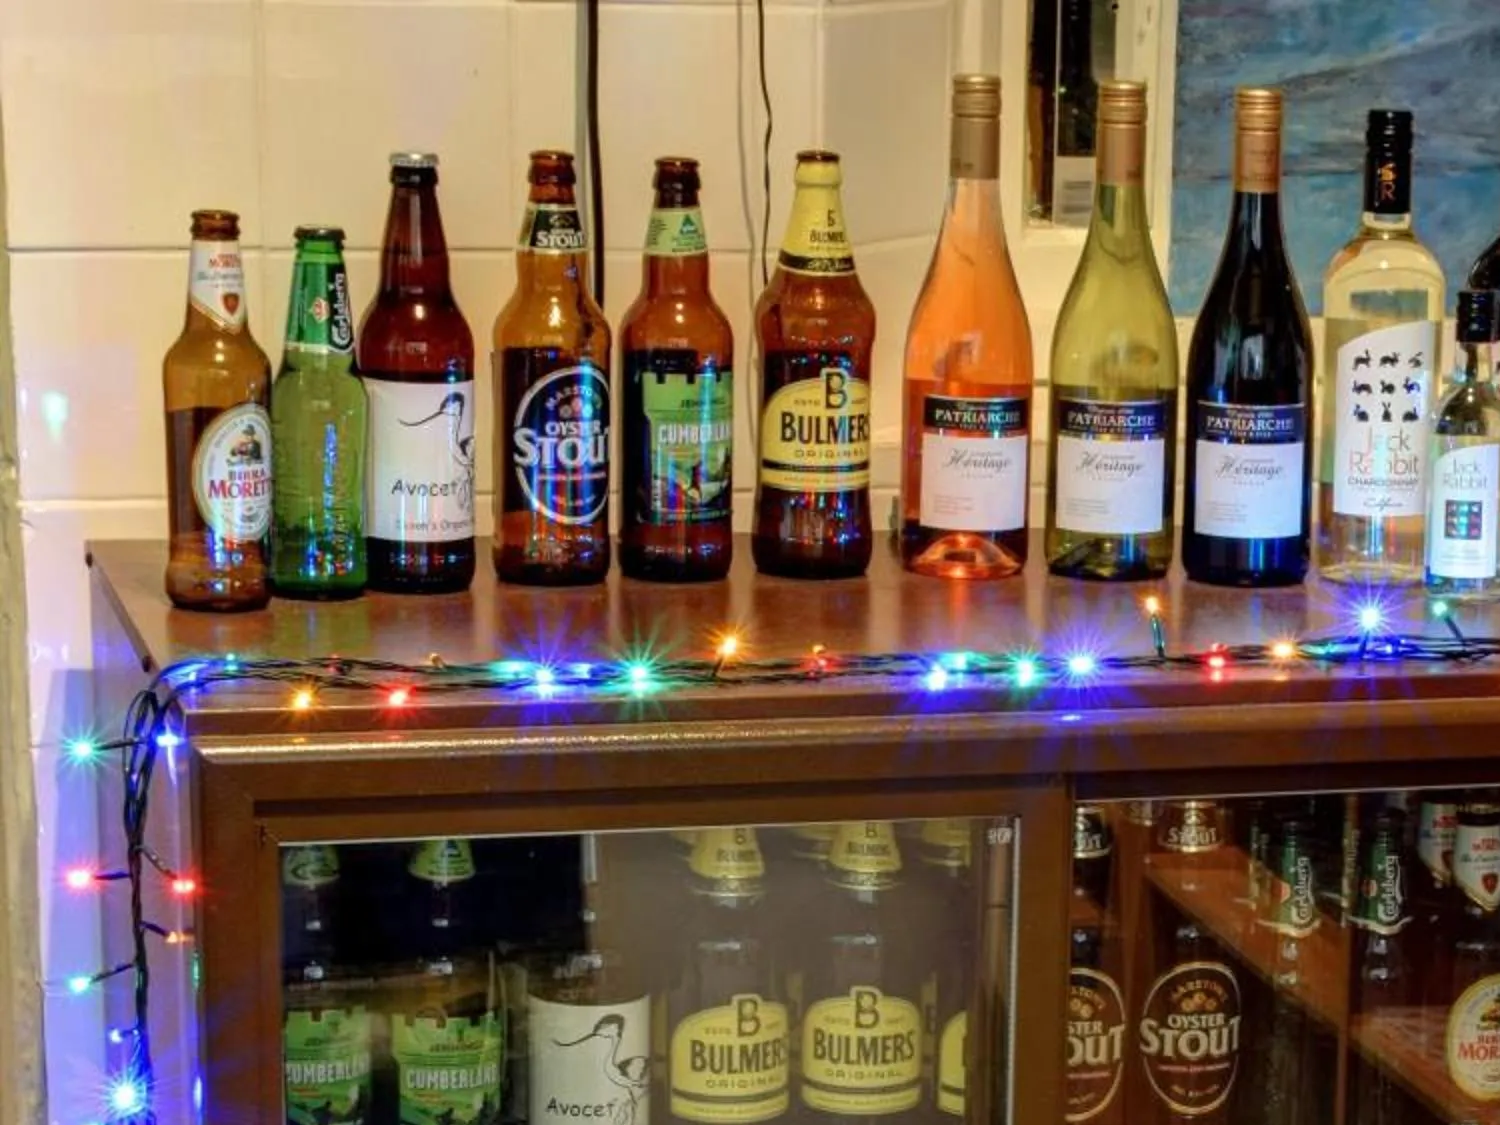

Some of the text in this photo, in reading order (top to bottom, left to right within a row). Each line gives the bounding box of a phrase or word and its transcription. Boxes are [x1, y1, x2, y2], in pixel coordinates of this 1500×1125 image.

[826, 372, 847, 409] B
[935, 408, 1020, 424] PATRIARCHE
[1068, 411, 1154, 426] PATRIARCHE
[1207, 416, 1293, 430] PATRIARCHE
[545, 421, 602, 436] OYSTER
[391, 479, 458, 496] Avocet
[736, 999, 760, 1037] B
[855, 990, 880, 1029] B
[1167, 1013, 1225, 1029] OYSTER
[813, 1027, 915, 1066] BULMERS
[1139, 1016, 1242, 1061] STOUT
[545, 1096, 615, 1118] Avocet
